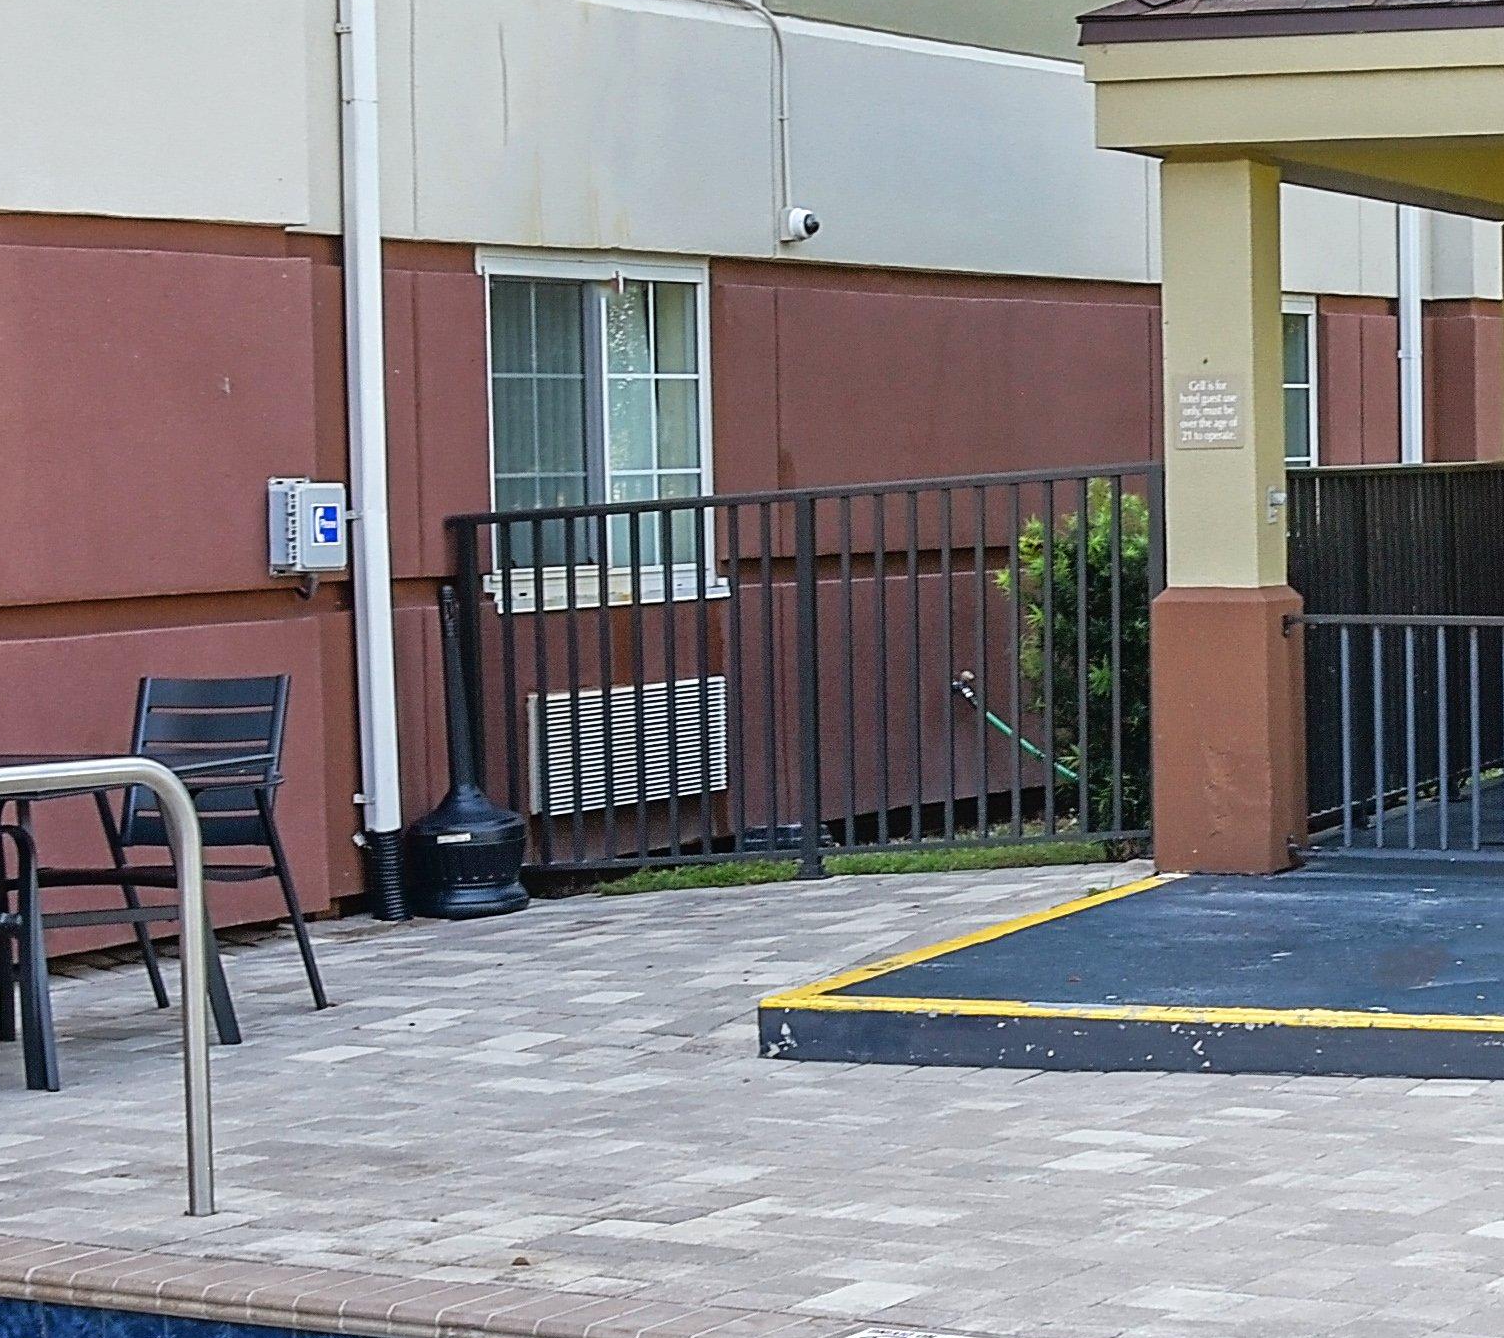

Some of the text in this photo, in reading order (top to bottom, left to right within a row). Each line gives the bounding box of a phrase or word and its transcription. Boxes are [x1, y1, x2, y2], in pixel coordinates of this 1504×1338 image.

[1215, 379, 1227, 391] for
[1179, 392, 1238, 406] hotel guest use
[1202, 406, 1223, 415] must
[1223, 404, 1235, 415] be
[1179, 415, 1238, 431] over the age of
[1181, 431, 1192, 441] 21
[1193, 431, 1203, 440] to
